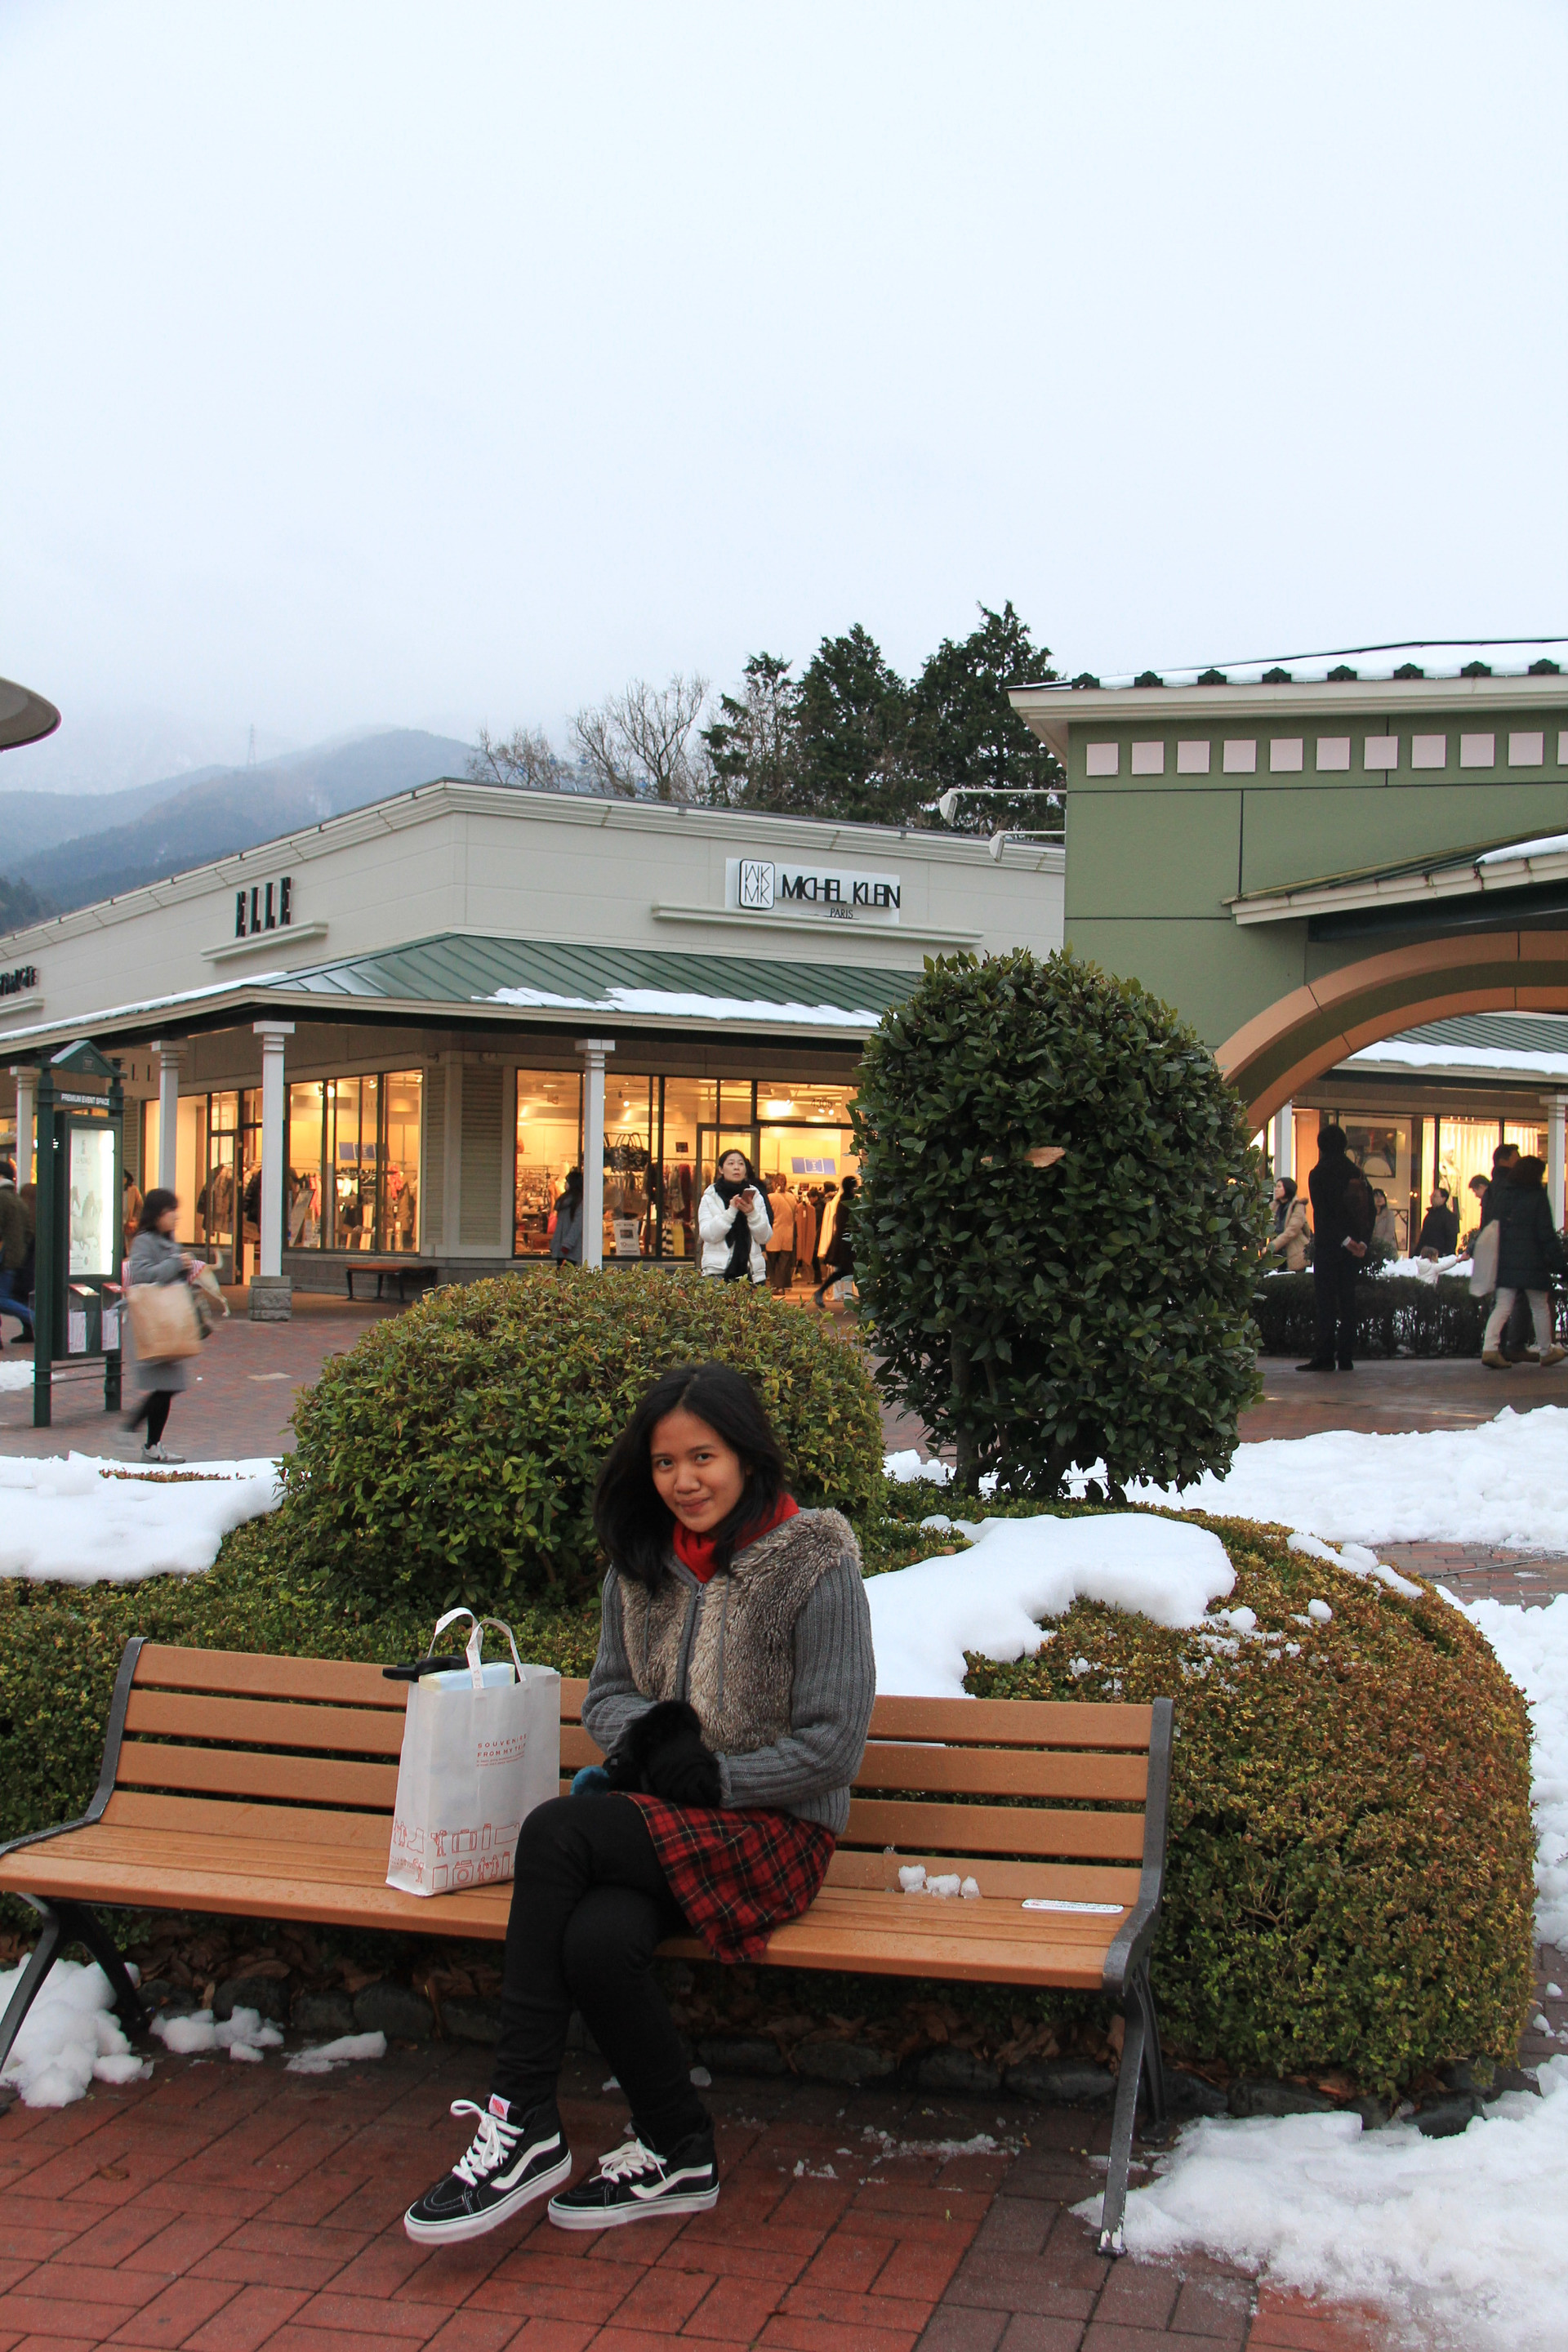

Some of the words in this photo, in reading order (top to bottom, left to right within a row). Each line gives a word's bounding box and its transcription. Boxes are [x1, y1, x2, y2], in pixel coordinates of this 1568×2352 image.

[782, 874, 847, 903] MICHEL
[853, 881, 901, 908] KLEIN
[235, 876, 292, 938] ELLE
[830, 907, 853, 919] PARIS
[61, 1093, 82, 1102] PREMIUM
[82, 1095, 96, 1104] EVENT
[96, 1097, 110, 1106] SPACE
[478, 1733, 527, 1748] SOUVENIRS
